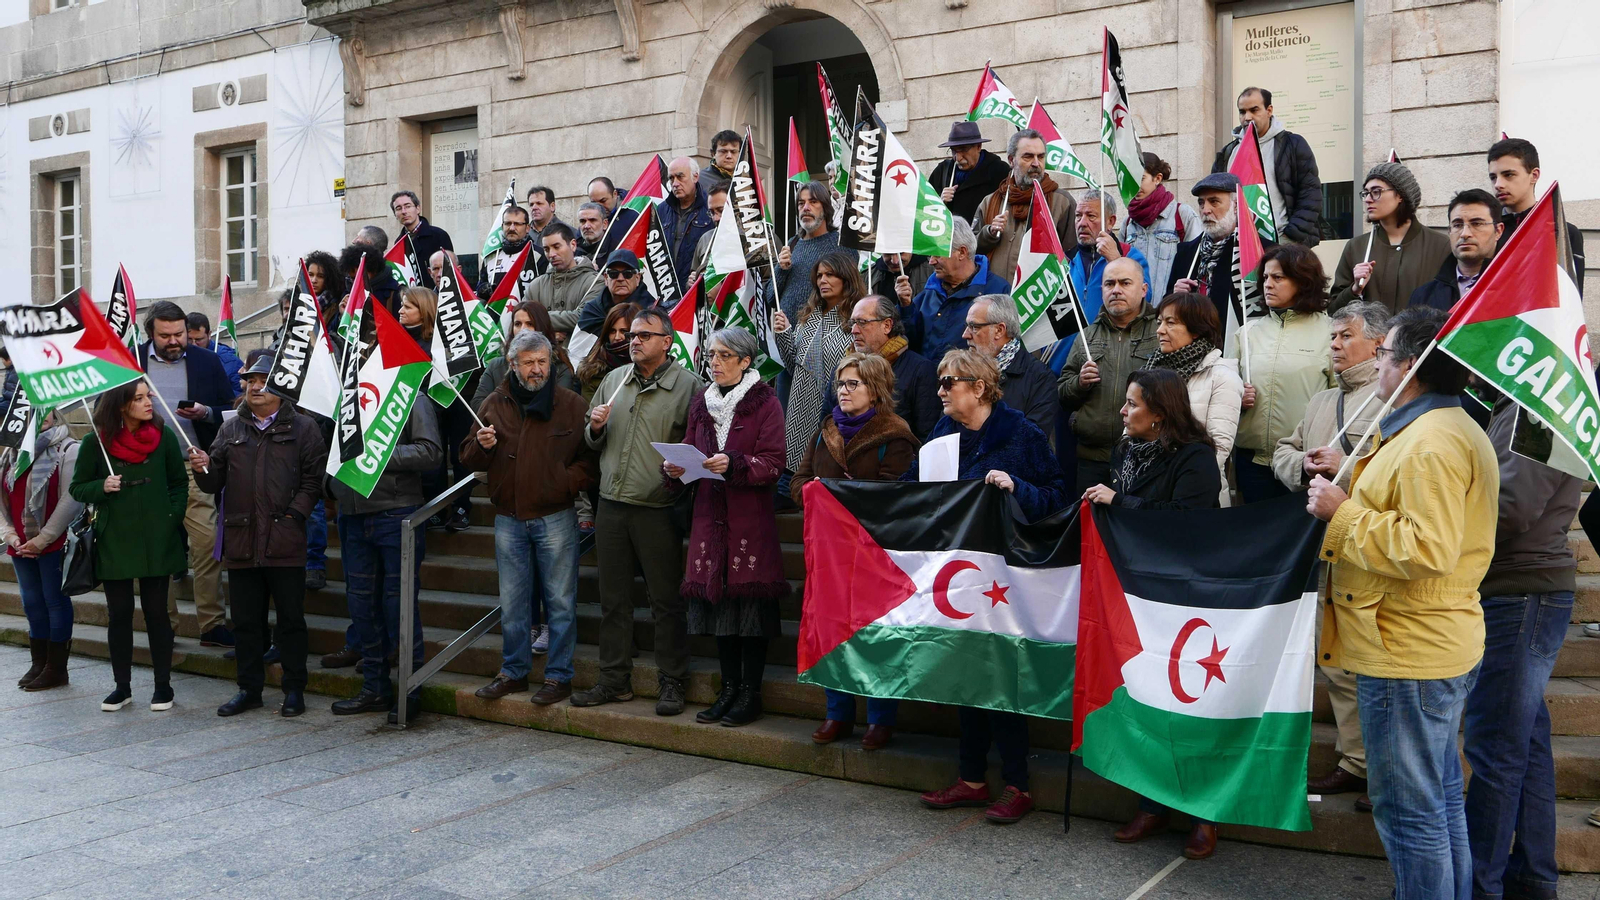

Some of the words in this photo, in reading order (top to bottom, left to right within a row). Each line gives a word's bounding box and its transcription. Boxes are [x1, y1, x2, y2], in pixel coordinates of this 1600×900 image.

[1245, 25, 1299, 40] Mulleres
[1245, 40, 1261, 51] do
[1263, 33, 1311, 50] silencio
[733, 160, 768, 252] SAHARA
[848, 128, 881, 233] SAHARA
[646, 229, 676, 302] SAHARA
[275, 293, 318, 390] SAHARA
[439, 276, 470, 361] SAHARA
[30, 365, 108, 400] GALICIA
[356, 381, 414, 475] GALICIA
